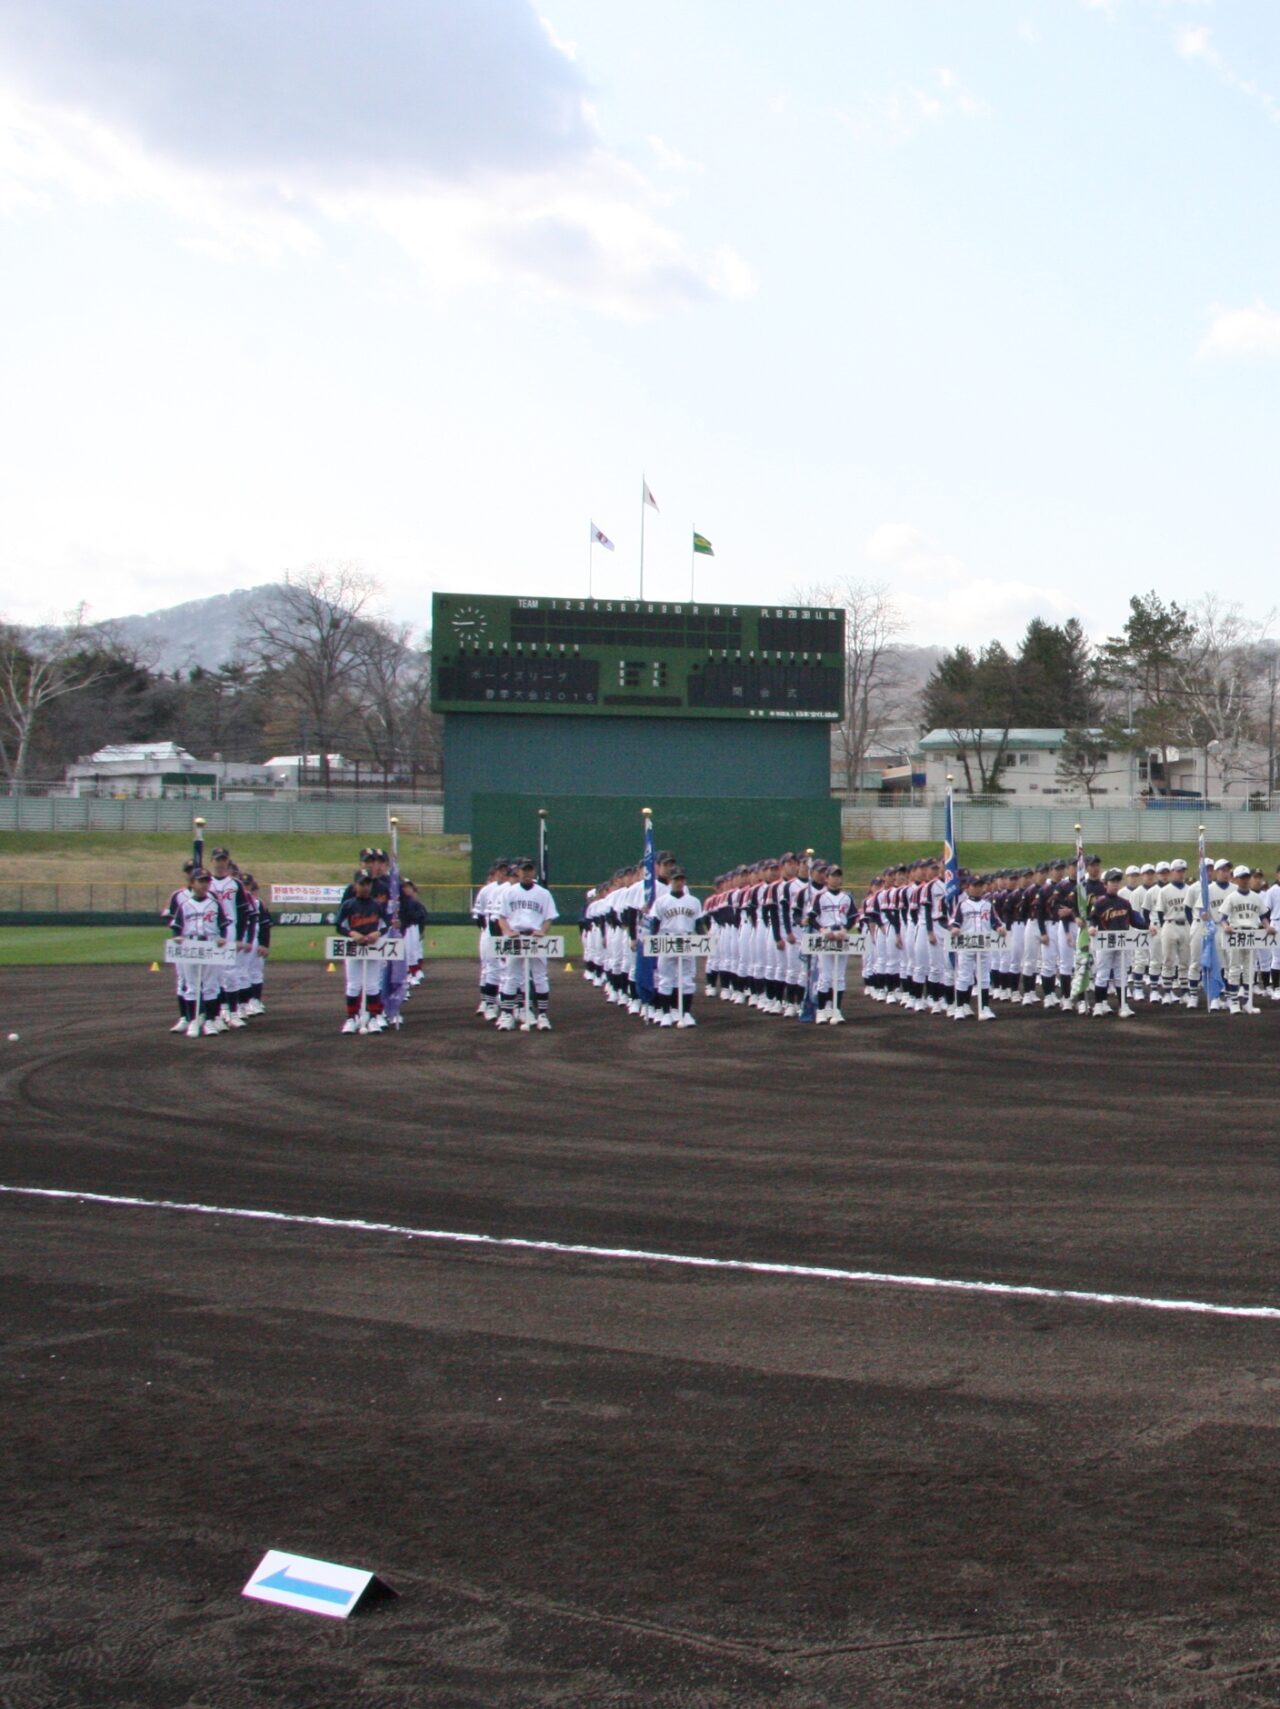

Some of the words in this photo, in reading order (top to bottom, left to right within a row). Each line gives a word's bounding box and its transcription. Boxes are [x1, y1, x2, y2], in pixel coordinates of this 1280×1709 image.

[518, 599, 538, 608] TEAM
[565, 601, 571, 610] 2
[579, 601, 585, 610] 3
[593, 602, 599, 611] 4
[606, 602, 612, 611] 5
[620, 603, 626, 612] 6
[634, 603, 640, 612] 7
[693, 606, 699, 615] R
[714, 607, 720, 616] H
[732, 607, 738, 616] E
[495, 937, 559, 956] 札幌豊平ボーイズ
[649, 937, 711, 954] 旭川大雪ボーイズ
[1097, 932, 1150, 949] 十勝ボーイズ
[1228, 931, 1278, 947] 石狩ボーイズ
[333, 939, 399, 957] 函館ボーイズ
